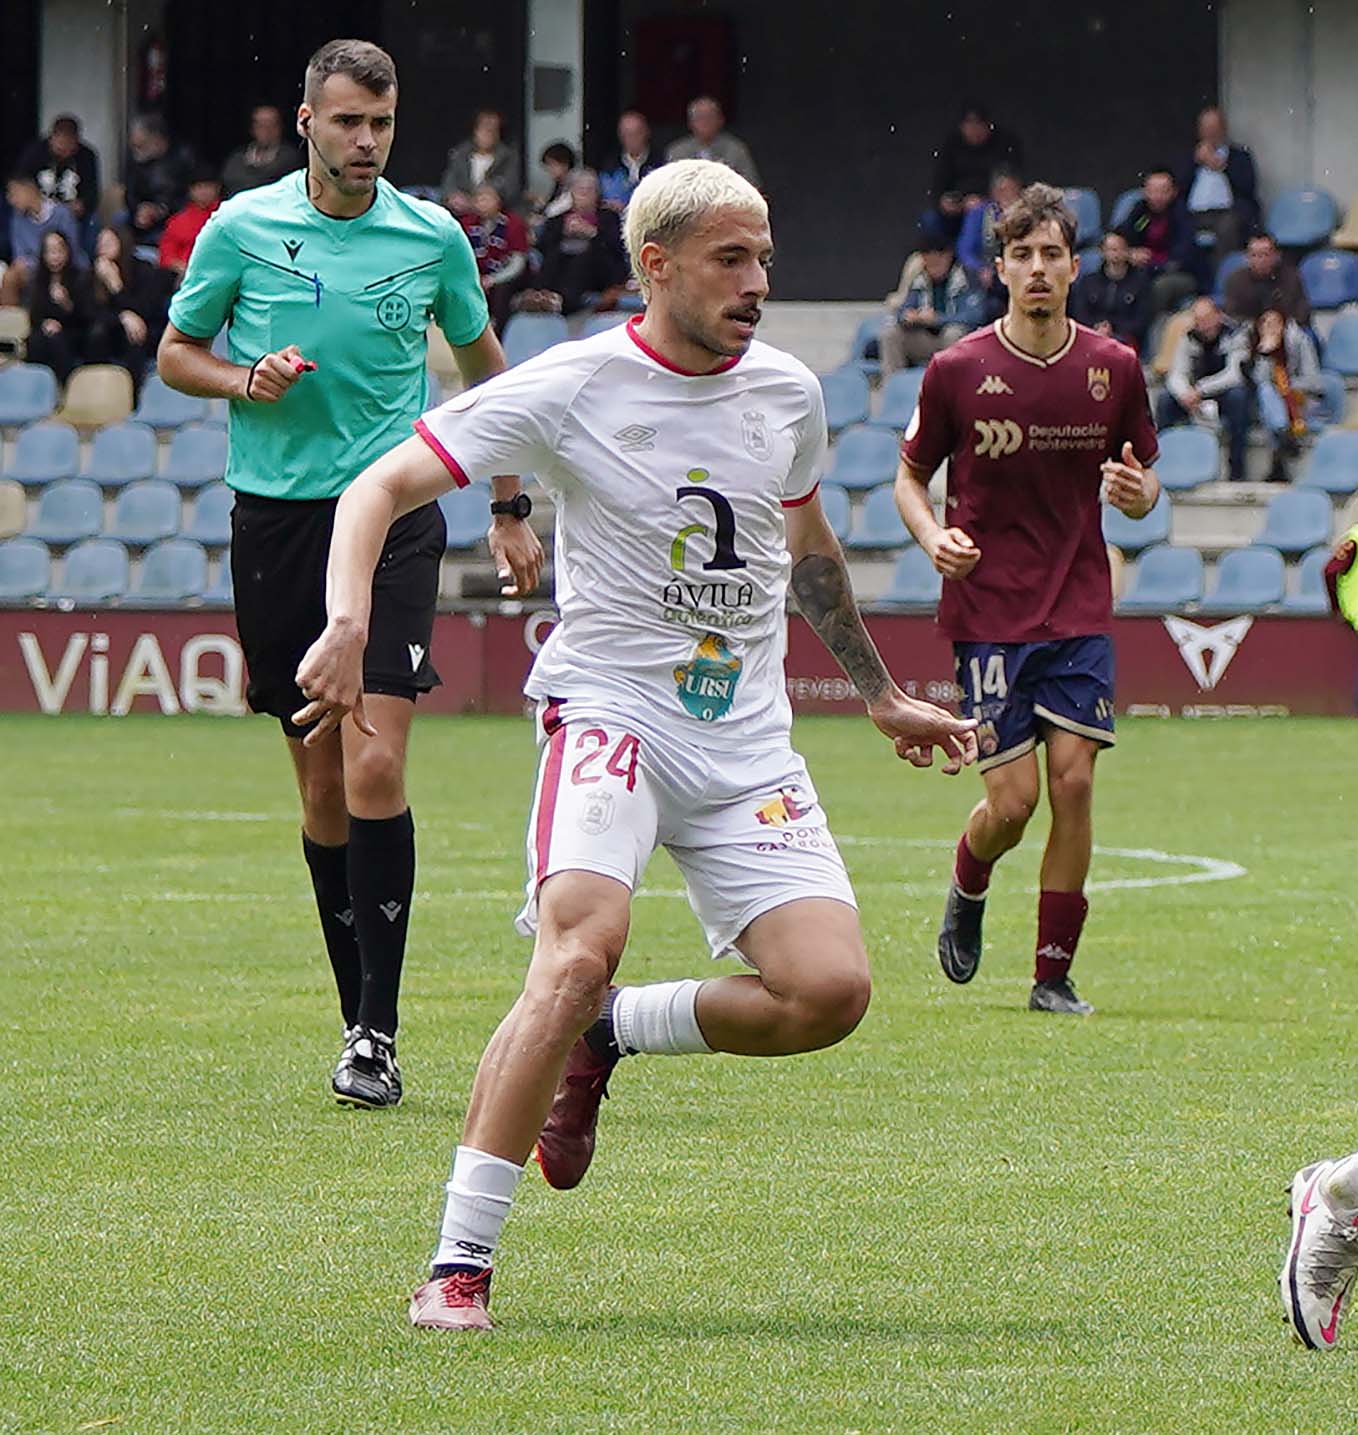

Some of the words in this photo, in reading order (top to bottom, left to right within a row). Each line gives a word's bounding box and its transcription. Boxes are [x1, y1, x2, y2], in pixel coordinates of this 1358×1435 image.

[663, 577, 753, 608] ÁVILA
[17, 632, 249, 716] ViAQ
[970, 655, 1008, 703] 14
[571, 729, 640, 792] 24
